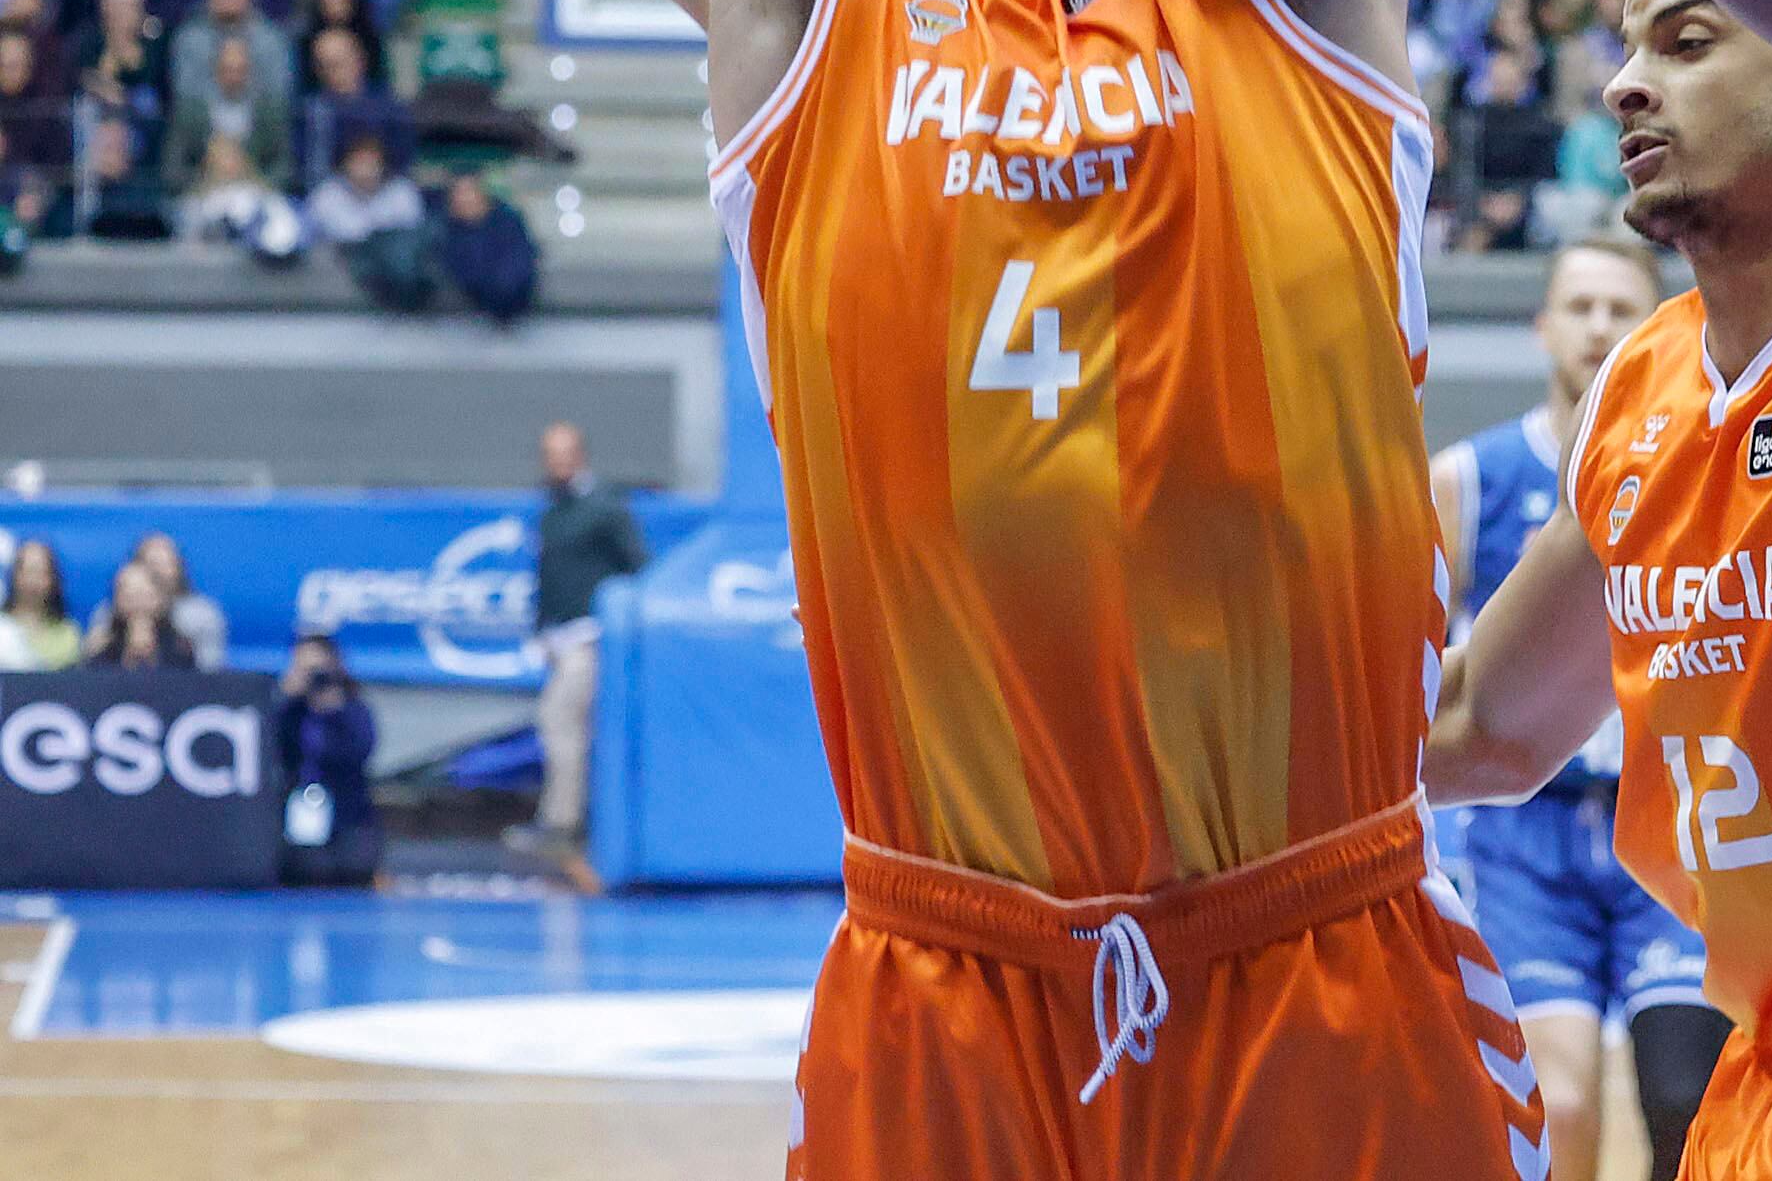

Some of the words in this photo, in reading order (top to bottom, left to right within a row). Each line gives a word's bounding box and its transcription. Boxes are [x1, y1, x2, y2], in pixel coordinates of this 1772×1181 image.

[943, 145, 1134, 201] BASKET
[968, 260, 1081, 420] 4
[0, 701, 260, 798] esa
